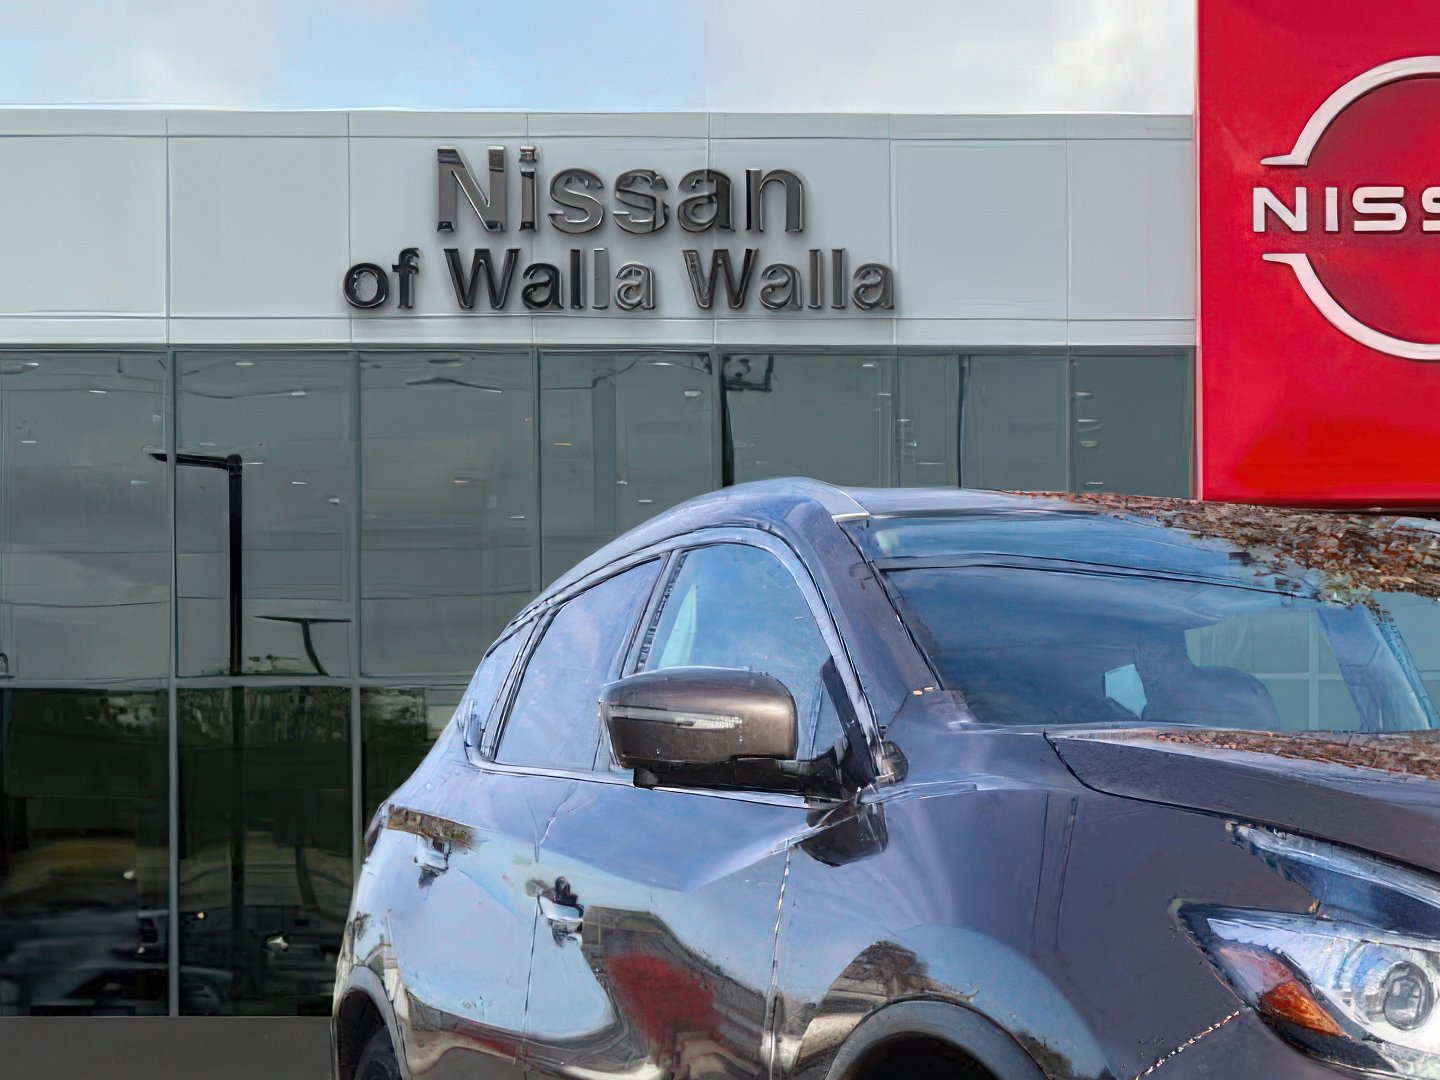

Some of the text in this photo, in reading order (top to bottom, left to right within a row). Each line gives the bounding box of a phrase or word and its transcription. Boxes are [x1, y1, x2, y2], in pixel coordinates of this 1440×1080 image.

[435, 144, 806, 234] Nissan
[342, 246, 895, 311] of Walla Walla
